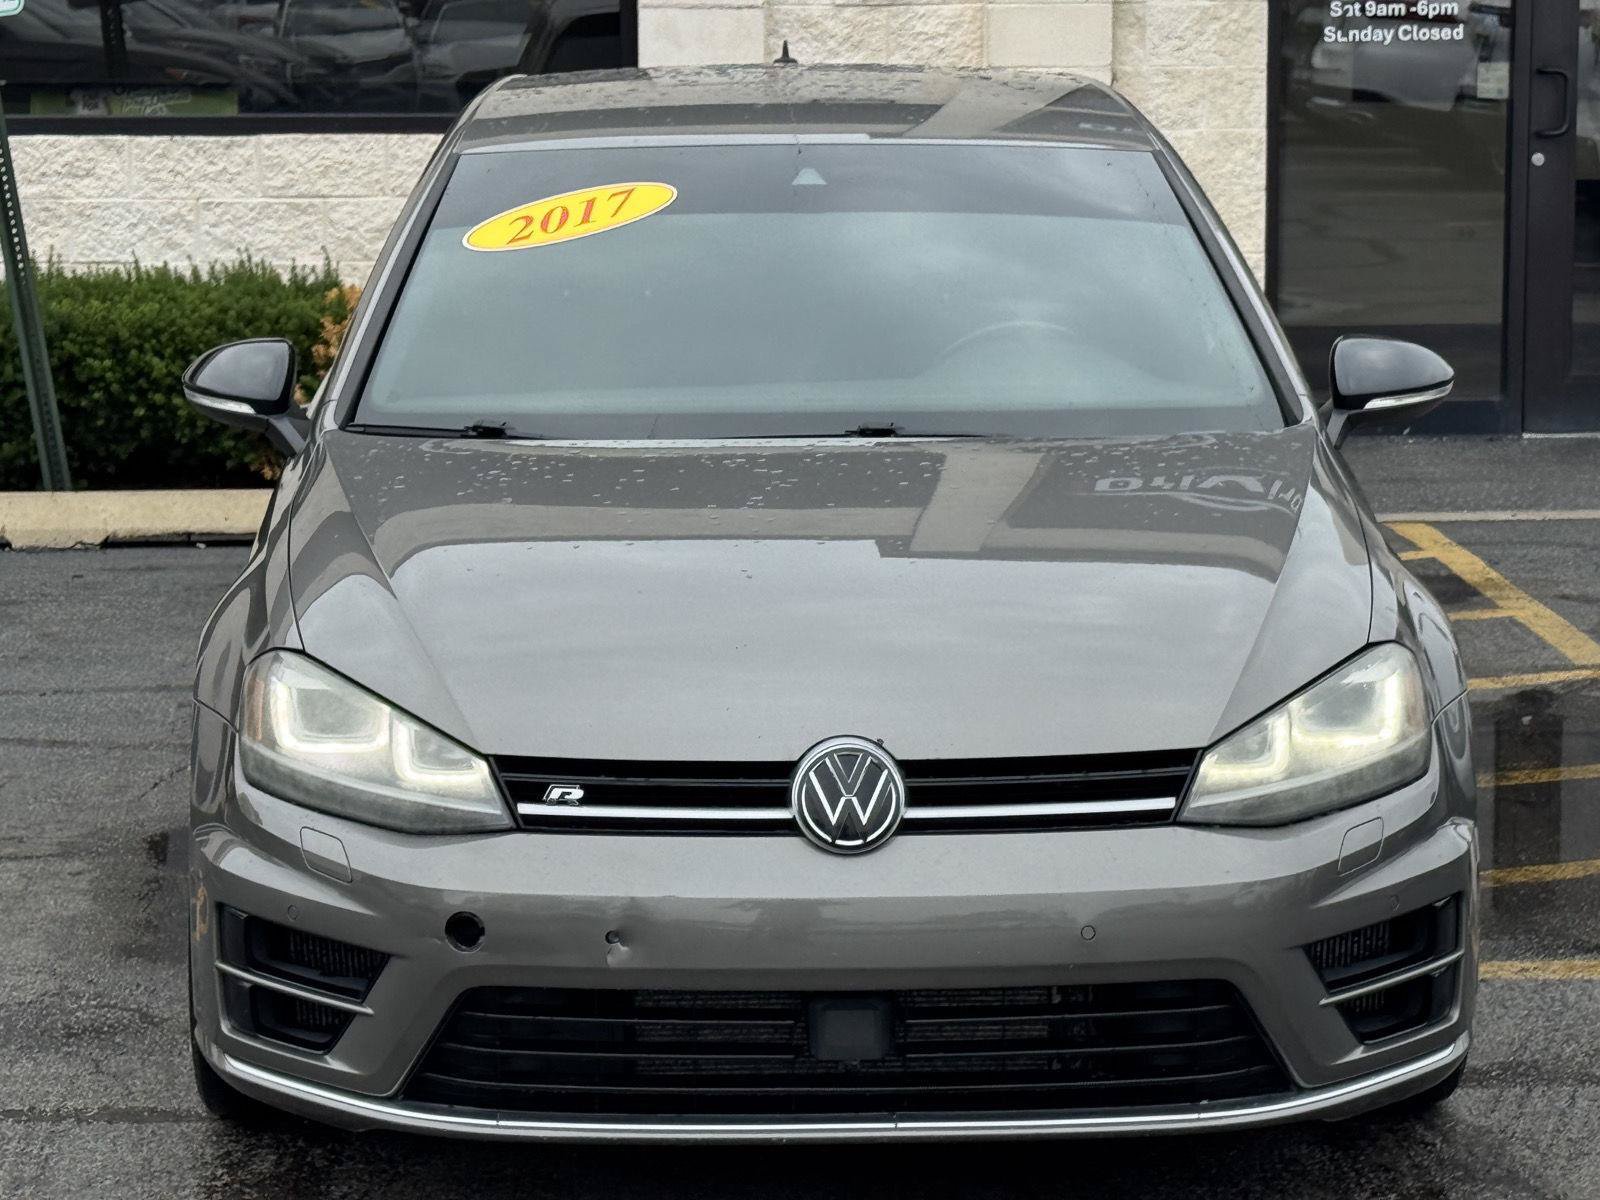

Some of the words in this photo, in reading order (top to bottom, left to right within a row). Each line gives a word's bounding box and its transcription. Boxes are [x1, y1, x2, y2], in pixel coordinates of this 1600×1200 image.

[1365, 0, 1406, 17] 9am
[1398, 23, 1464, 41] Closed
[505, 186, 637, 246] 2017
[542, 783, 585, 806] R
